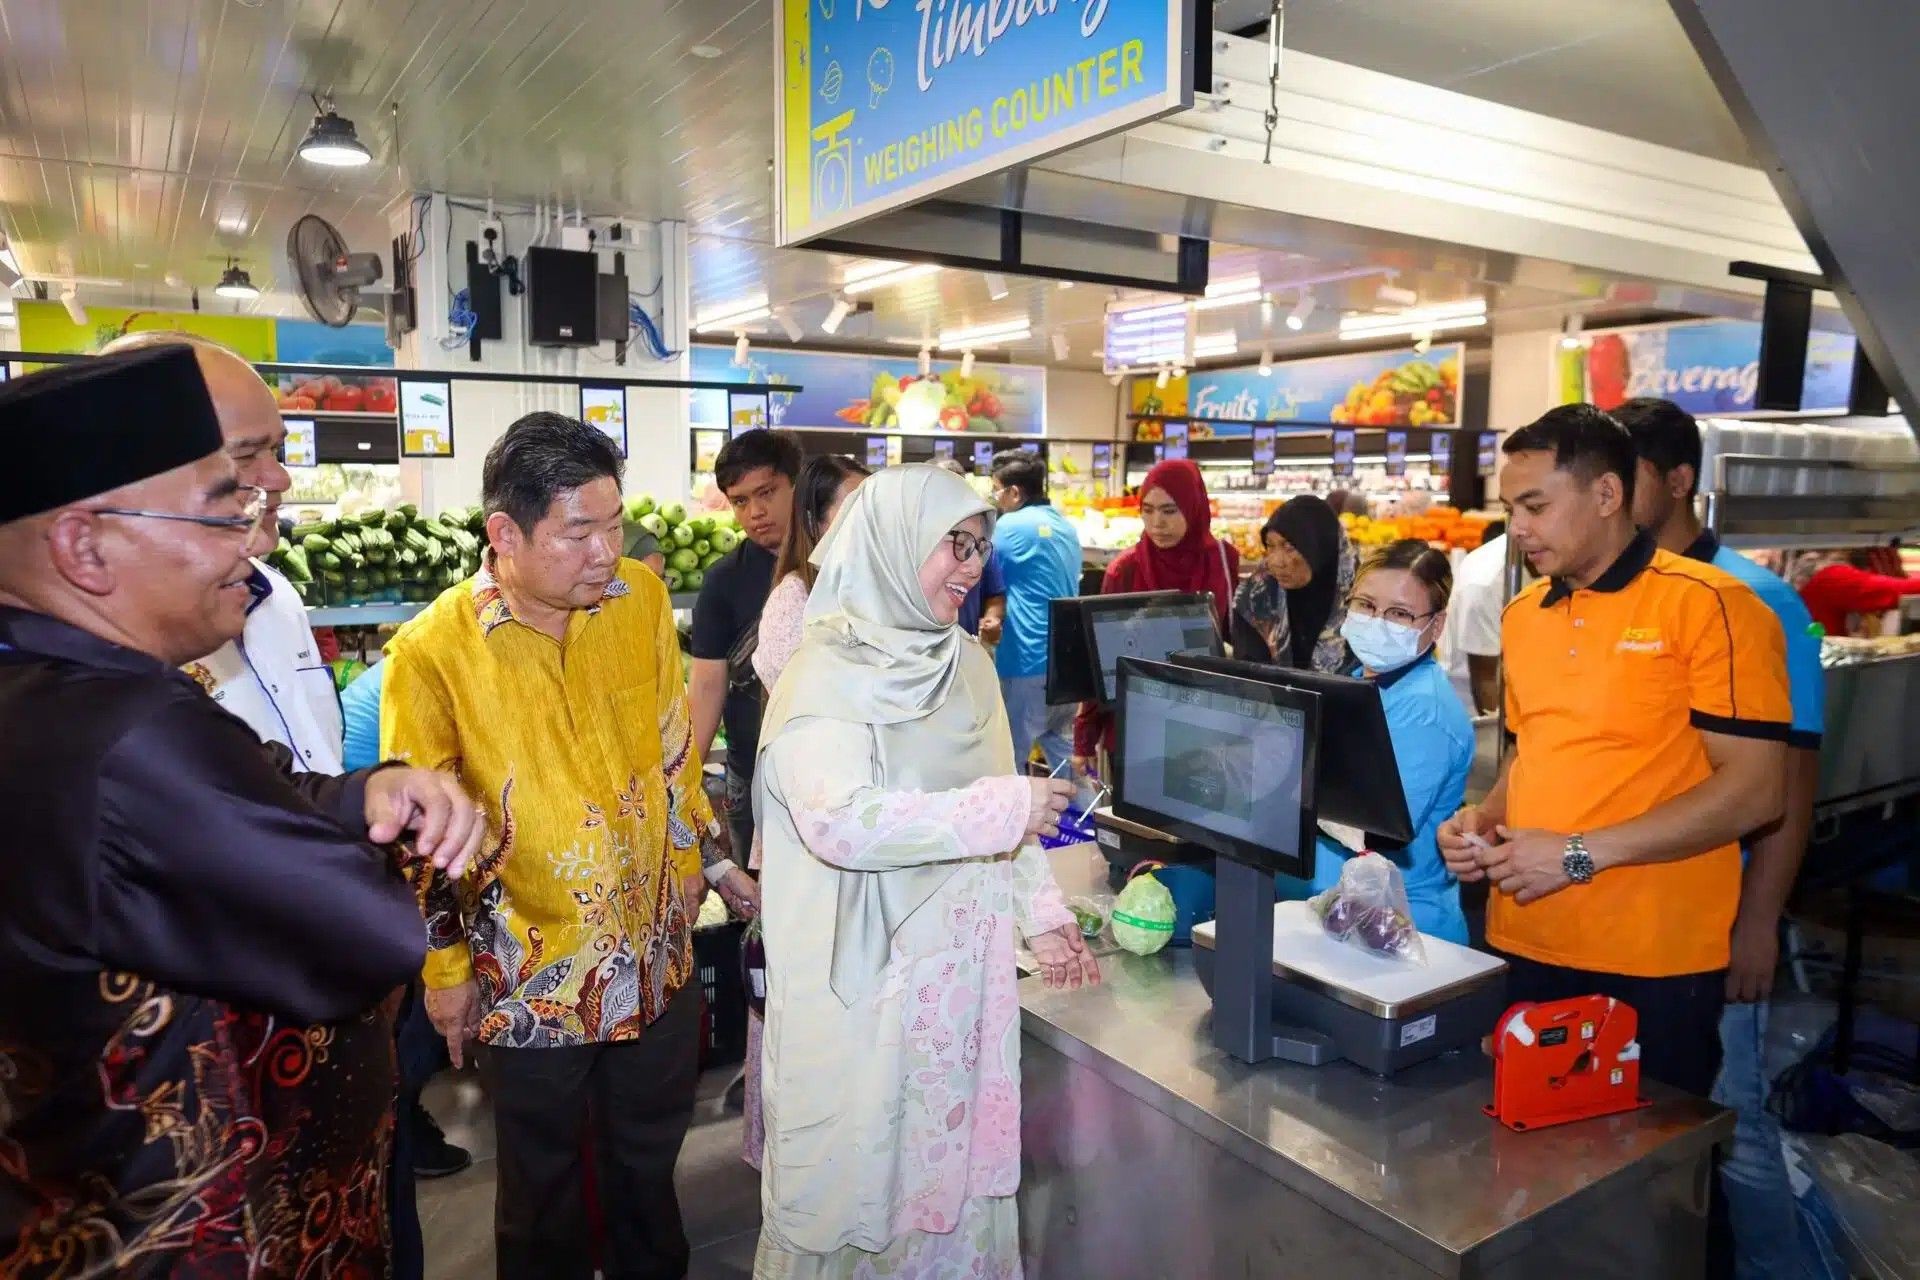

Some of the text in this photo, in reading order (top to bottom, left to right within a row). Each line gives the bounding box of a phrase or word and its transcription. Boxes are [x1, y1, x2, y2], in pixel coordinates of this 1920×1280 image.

[865, 39, 1144, 185] WEIGHING COUNTER
[1194, 385, 1259, 420] Fruits
